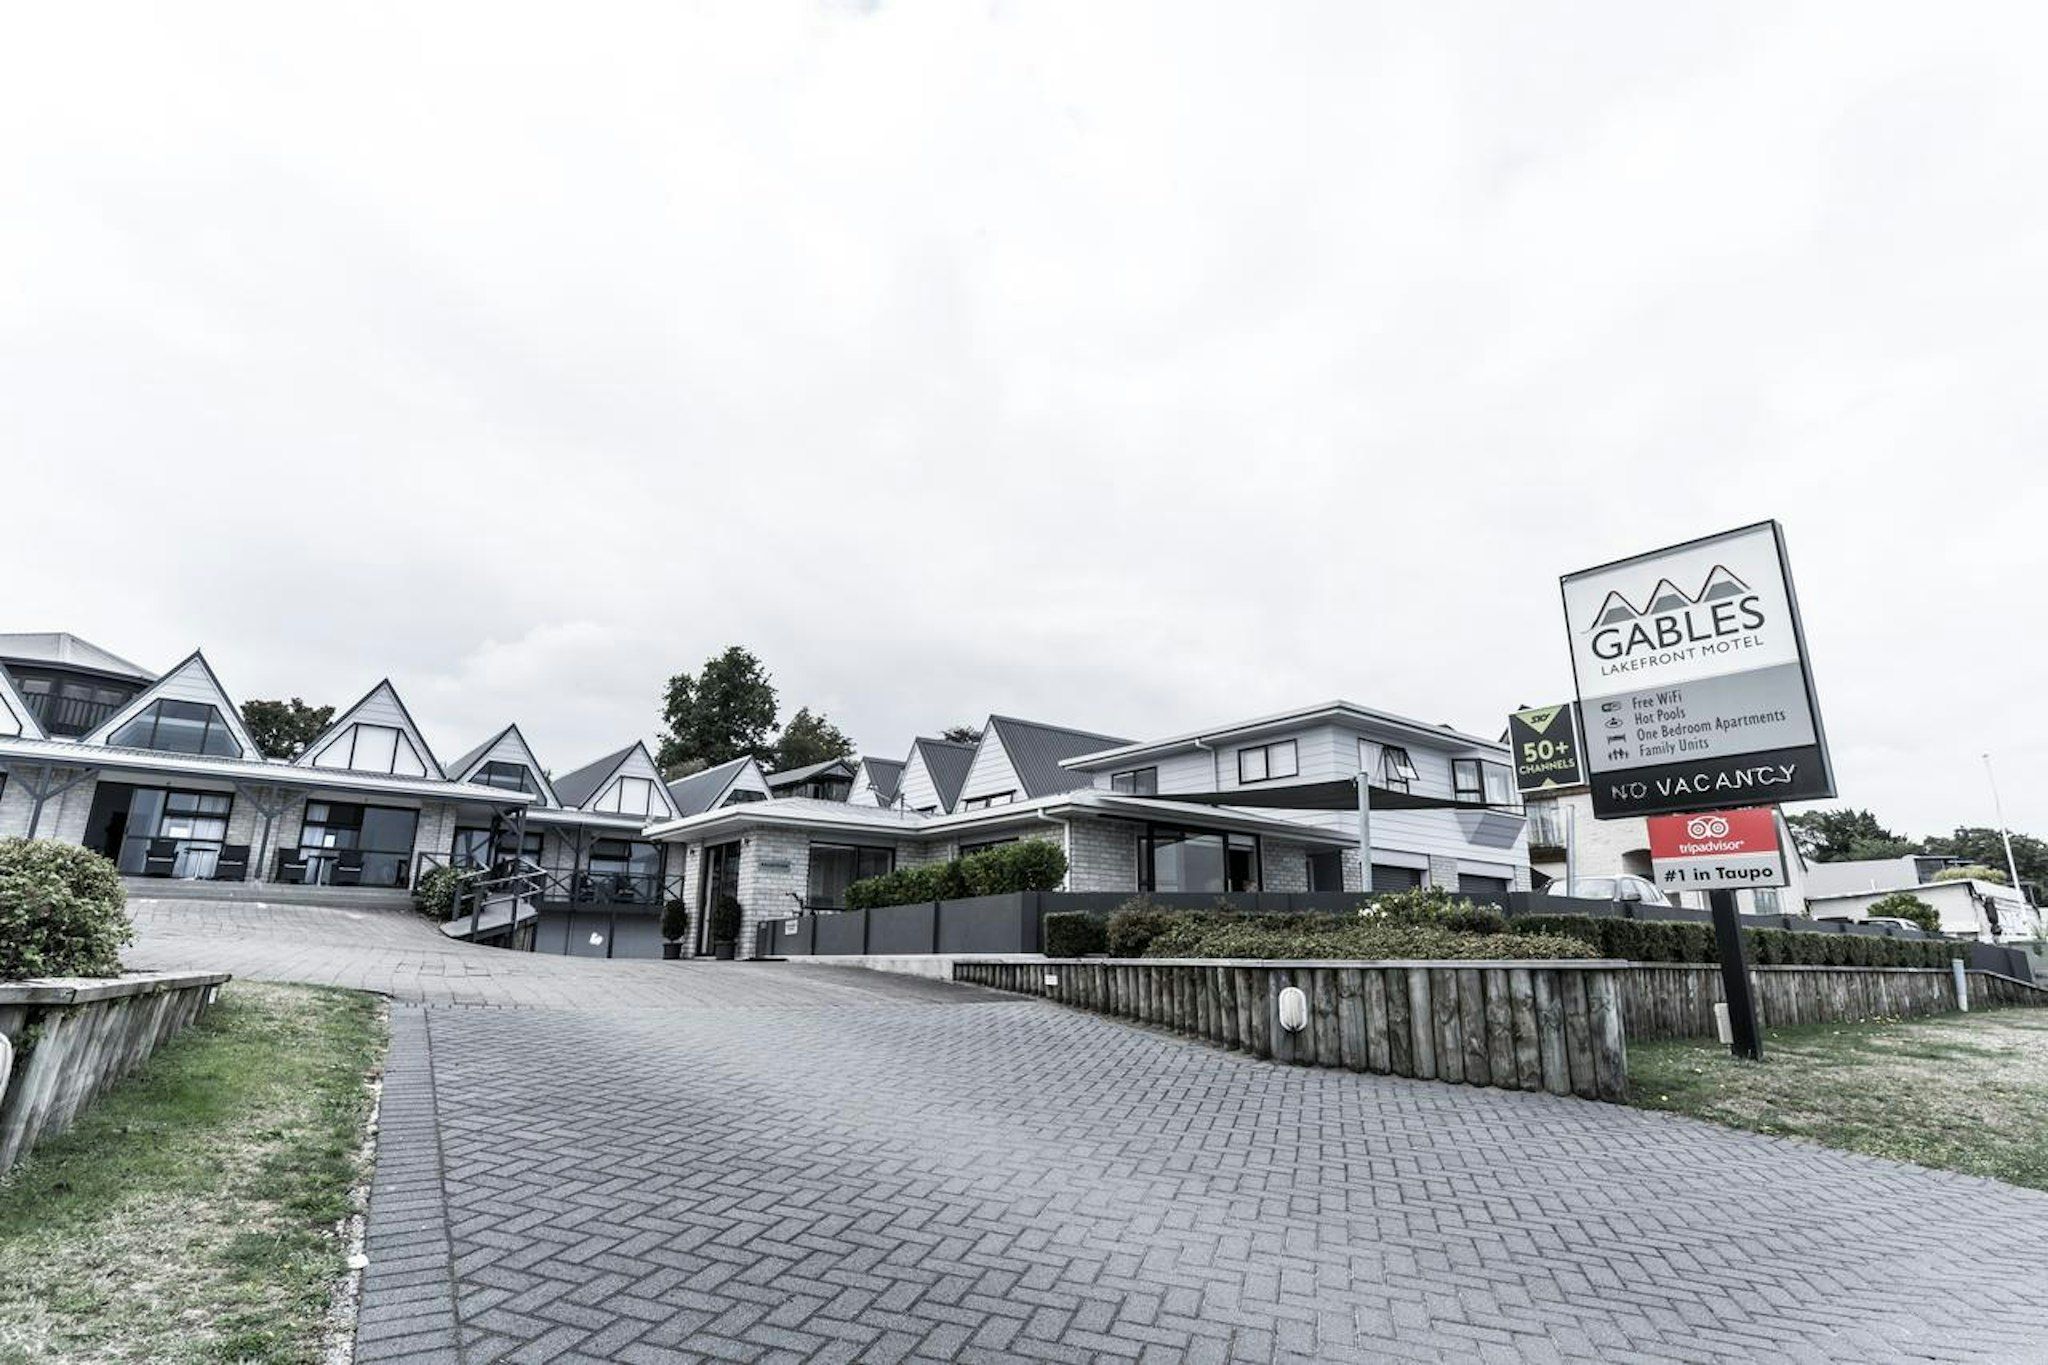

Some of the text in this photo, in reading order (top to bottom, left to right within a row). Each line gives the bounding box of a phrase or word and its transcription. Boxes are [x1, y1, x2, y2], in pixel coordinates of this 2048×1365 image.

[1592, 595, 1765, 660] GABLES
[1601, 635, 1764, 676] LAKEFRONT MOTEL
[1632, 690, 1682, 710] Free WiFi
[1634, 706, 1686, 725] Hot Pools
[1637, 709, 1786, 742] One Bedroom Apartments
[1523, 739, 1569, 763] 50+
[1639, 737, 1709, 757] Family Units
[1518, 758, 1576, 775] CHANNELS
[1611, 764, 1796, 801] NO VACANCY
[1679, 840, 1741, 855] tripadvisor
[1664, 867, 1773, 883] #1 in Taupo
